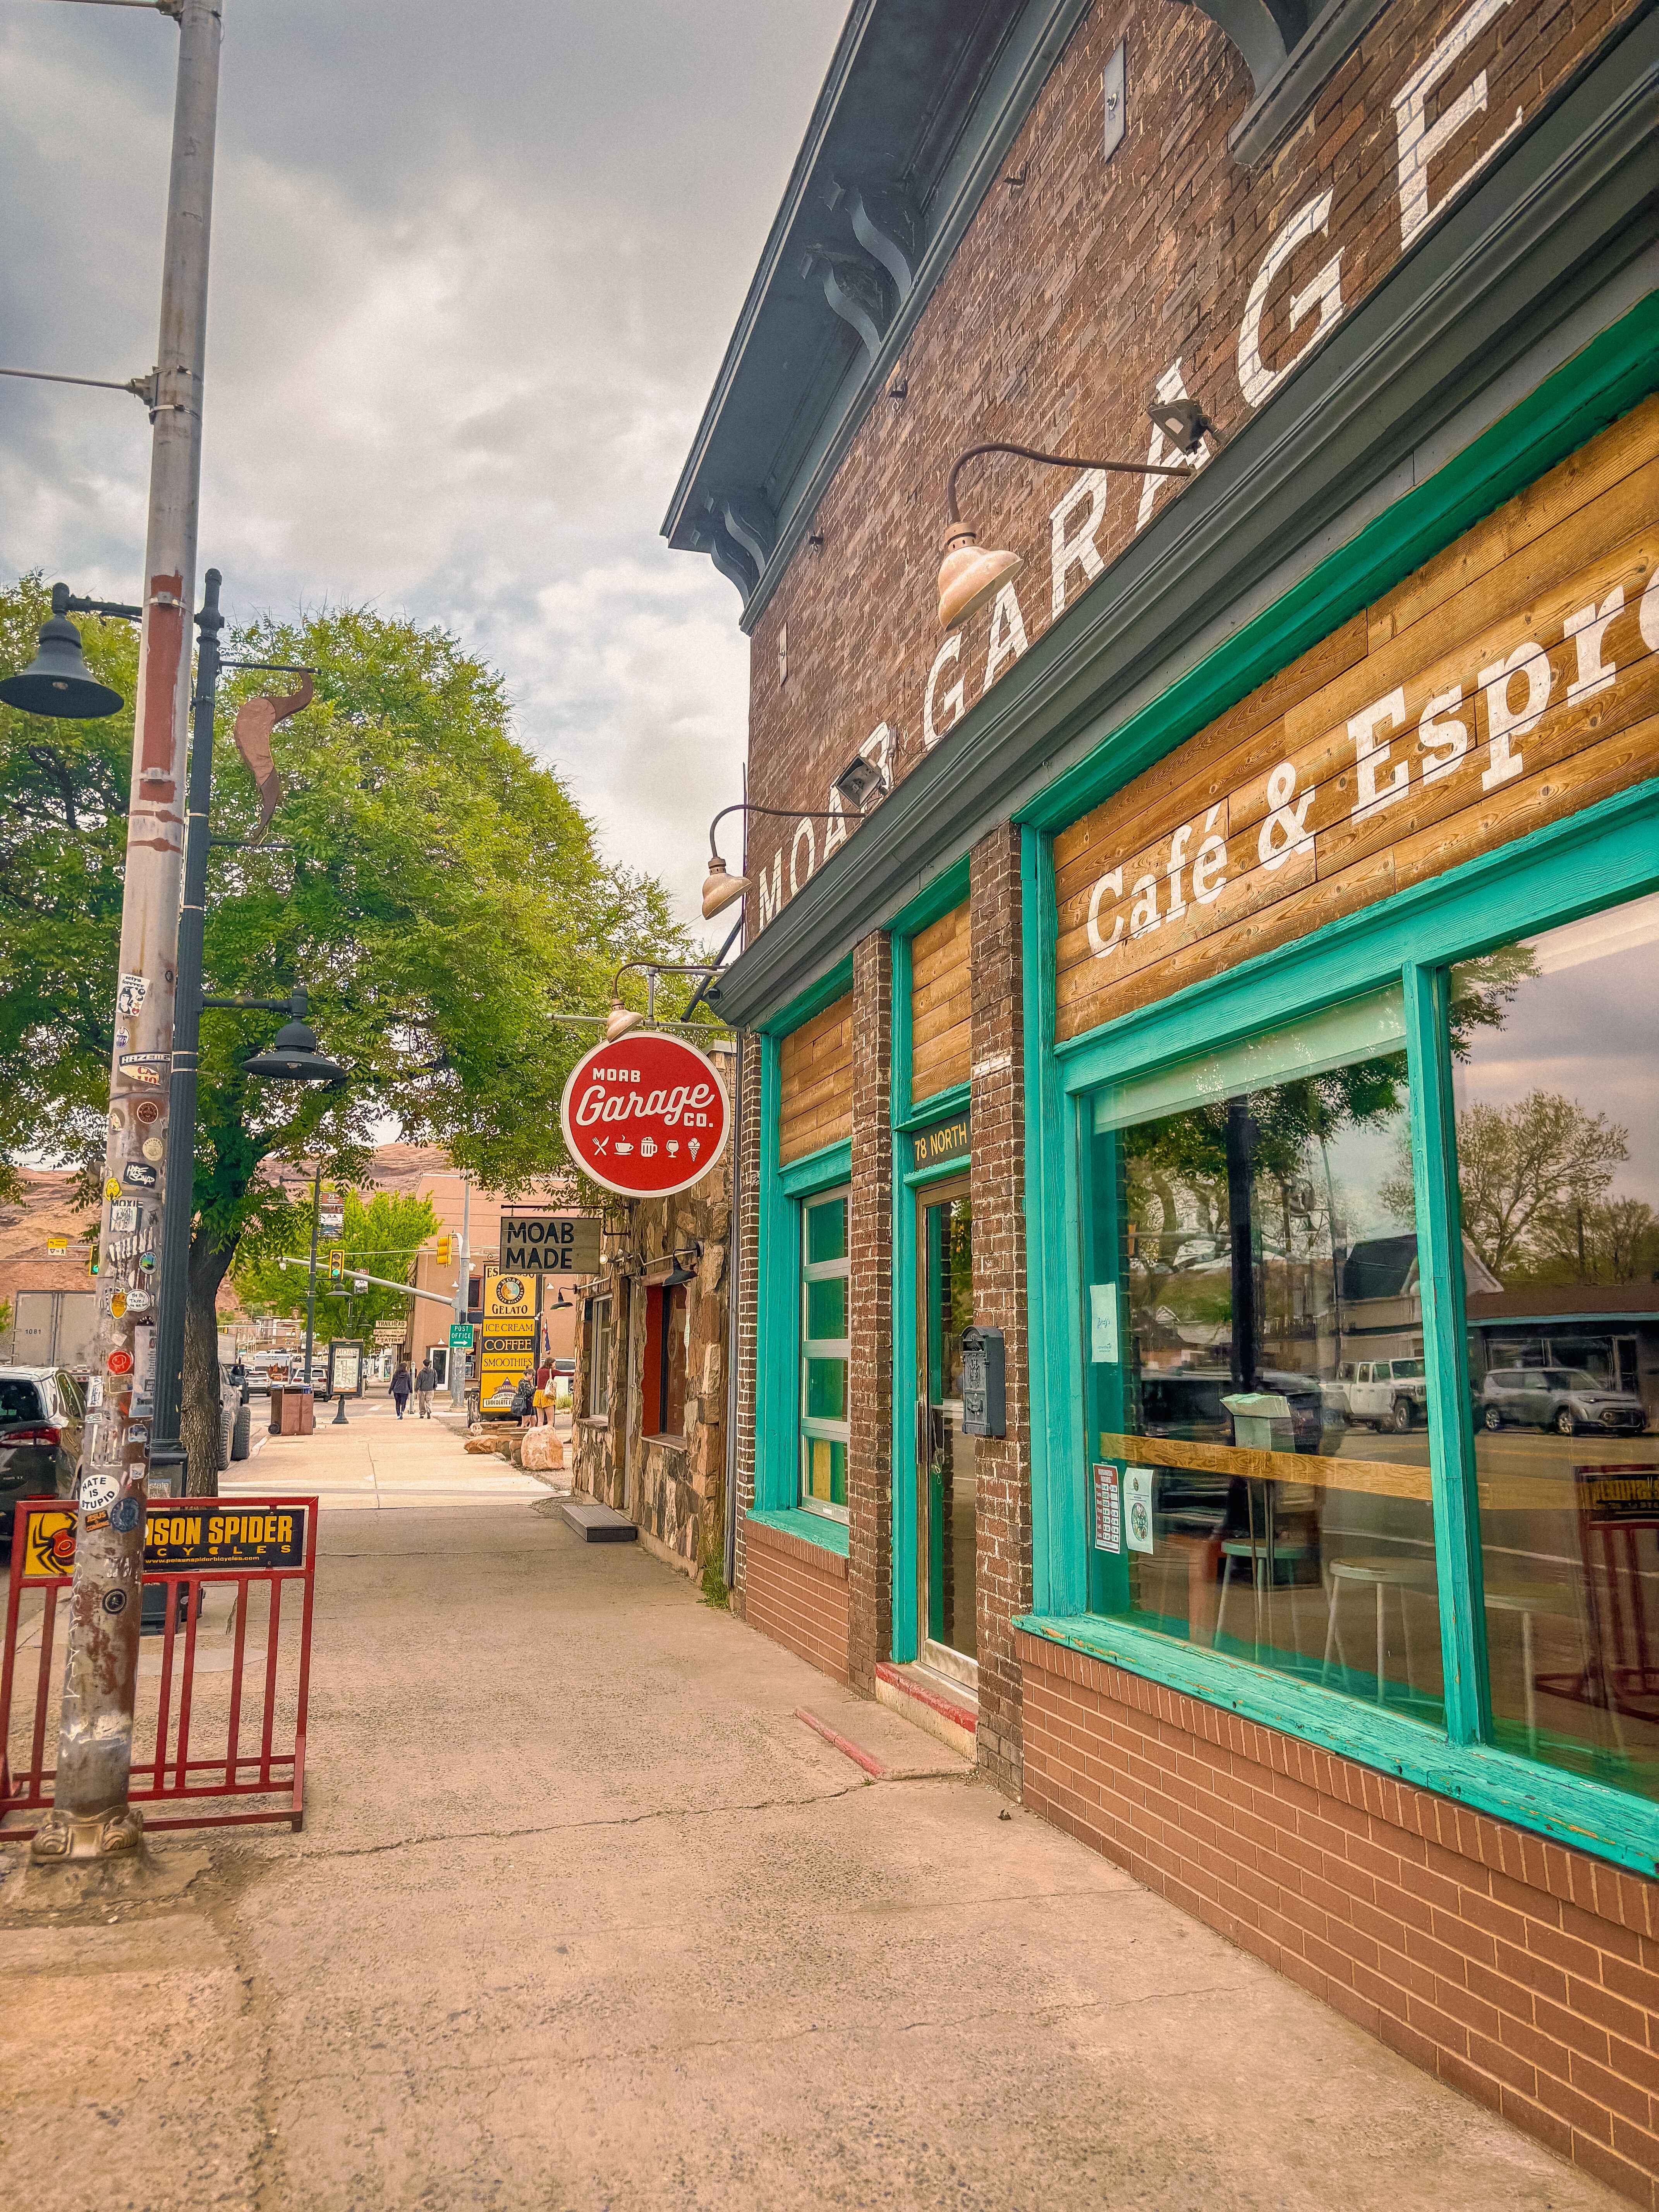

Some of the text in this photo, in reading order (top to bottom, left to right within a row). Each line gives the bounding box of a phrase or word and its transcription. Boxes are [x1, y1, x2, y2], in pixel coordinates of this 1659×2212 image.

[923, 0, 1523, 752] GARAGE
[1088, 804, 1229, 959] Café
[1258, 762, 1317, 871] &
[592, 1067, 641, 1083] MOAB
[575, 1083, 715, 1126] Garage
[684, 1112, 714, 1127] CO.
[914, 1121, 967, 1161] 78 NORTH
[507, 1222, 574, 1244] MOAB
[506, 1247, 573, 1269] MADE
[492, 1304, 528, 1314] GELATO
[486, 1323, 533, 1332] ICE CREAM
[484, 1339, 532, 1351] COFFEE
[484, 1358, 532, 1367] SMOOTHIES
[82, 1477, 106, 1492] HATE
[82, 1491, 115, 1509] STUPID
[89, 1489, 98, 1498] IS
[146, 1515, 293, 1546] ISON SPIDER
[157, 1544, 292, 1557] CYCLES
